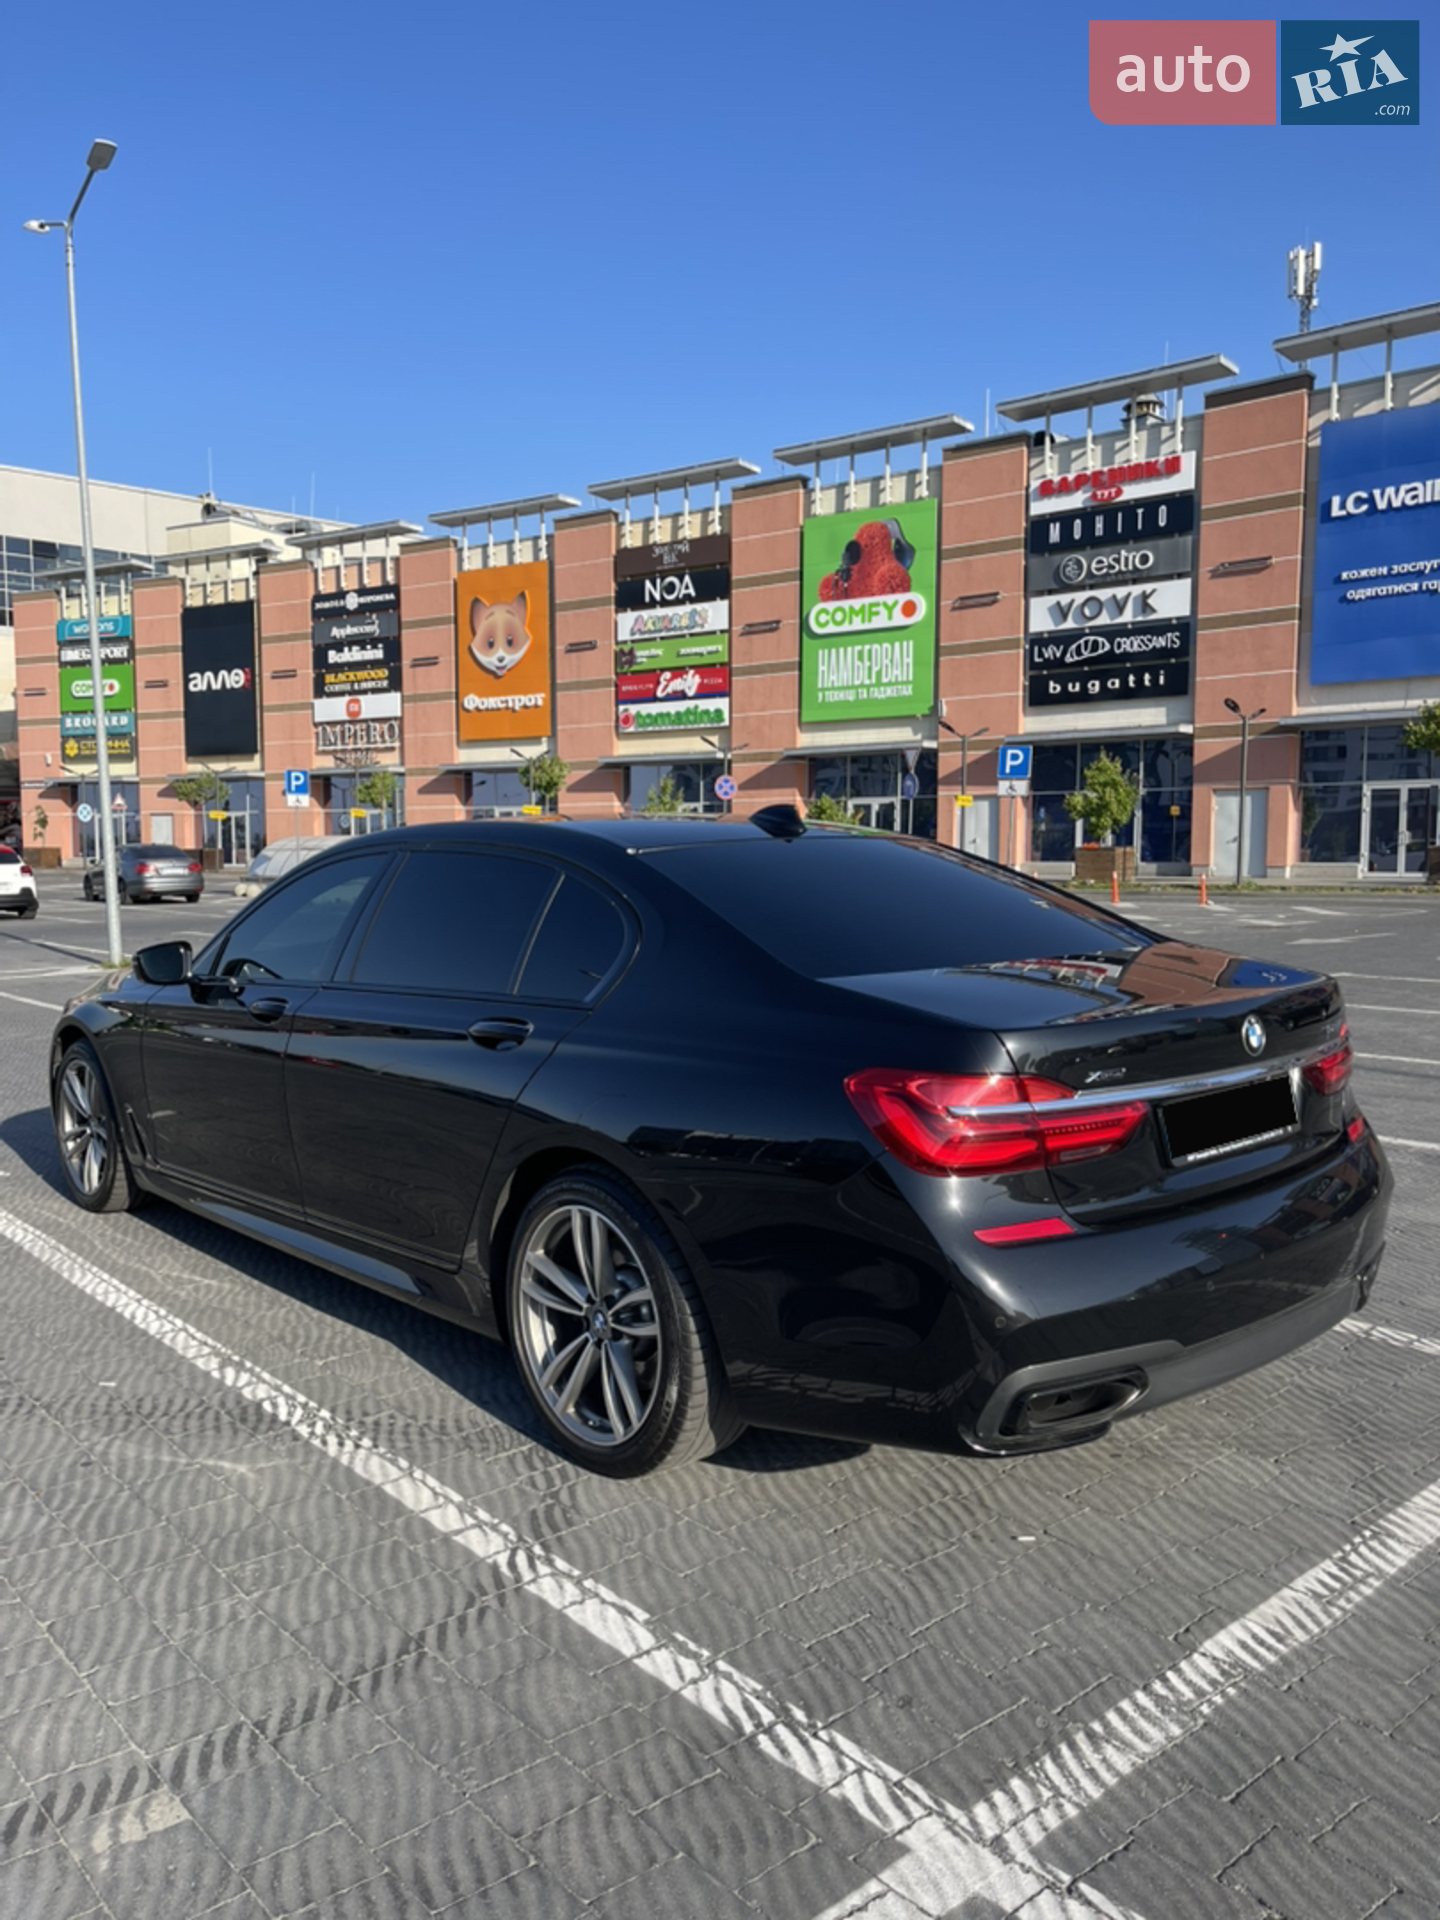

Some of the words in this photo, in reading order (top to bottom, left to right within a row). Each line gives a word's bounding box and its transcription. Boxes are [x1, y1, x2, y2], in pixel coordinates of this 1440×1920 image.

[1331, 491, 1369, 518] LC
[1048, 504, 1168, 544] MOHITO
[1091, 549, 1154, 575] estro
[644, 573, 696, 603] NOA
[814, 600, 898, 629] COMFY
[1055, 588, 1158, 623] VOVK
[327, 643, 384, 664] Baldinini
[817, 640, 914, 689] НАМБЕРВАН
[1048, 670, 1166, 694] bugatti
[636, 704, 725, 728] tomatina
[317, 721, 400, 748] IMPERO
[1006, 749, 1025, 775] P
[290, 772, 305, 792] P
